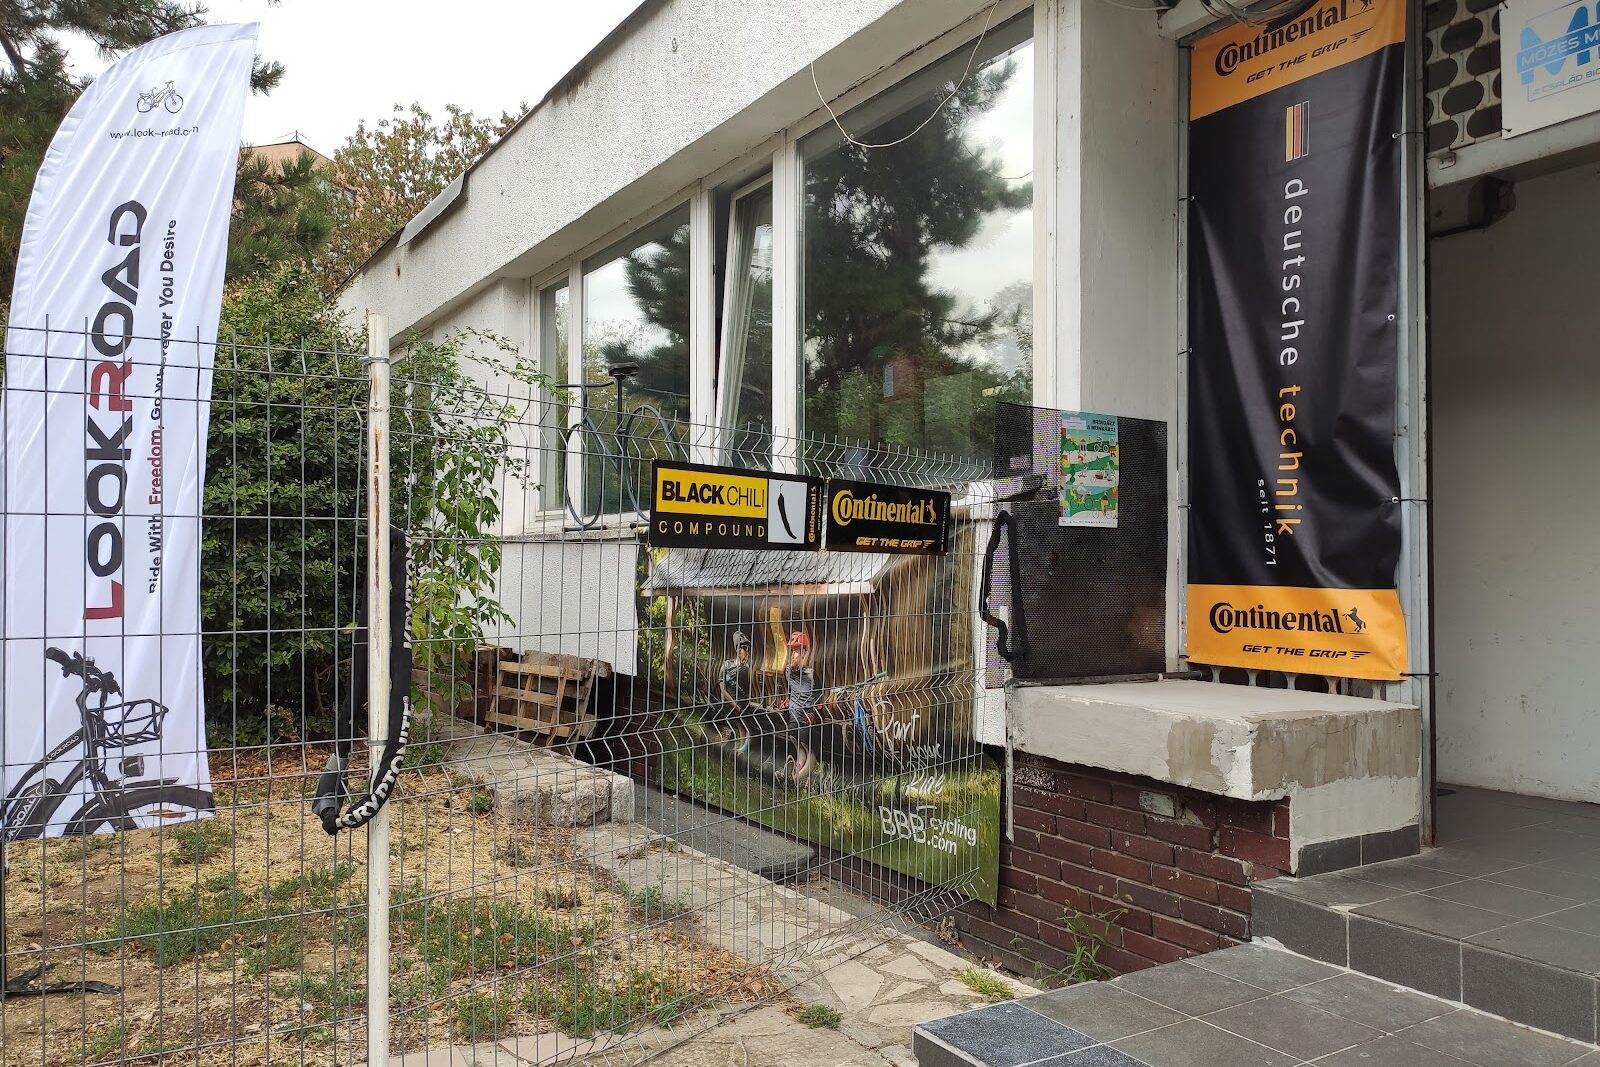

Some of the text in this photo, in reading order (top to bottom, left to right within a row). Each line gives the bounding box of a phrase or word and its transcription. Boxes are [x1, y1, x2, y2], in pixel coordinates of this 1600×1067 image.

[1215, 1, 1348, 76] Continental
[1246, 38, 1348, 84] GET THE GRIP
[160, 219, 177, 272] Desire
[1279, 178, 1309, 366] deutsche
[159, 277, 174, 308] You
[84, 200, 148, 620] LOOKROAD
[150, 398, 162, 421] Go
[1275, 384, 1303, 535] technik
[662, 480, 765, 508] BLACK CHILI
[832, 489, 925, 526] Continental
[148, 513, 162, 553] With
[658, 520, 765, 537] COMPOUND
[808, 493, 817, 543] Continental
[1257, 479, 1277, 566] seit 1871
[855, 536, 923, 549] GET THE GRIP
[1209, 602, 1345, 634] Continental
[1242, 644, 1347, 659] GET THE GRIP
[336, 700, 410, 828] KRYPTONITE
[879, 805, 977, 846] BBB cycling
[926, 833, 958, 855] .com
